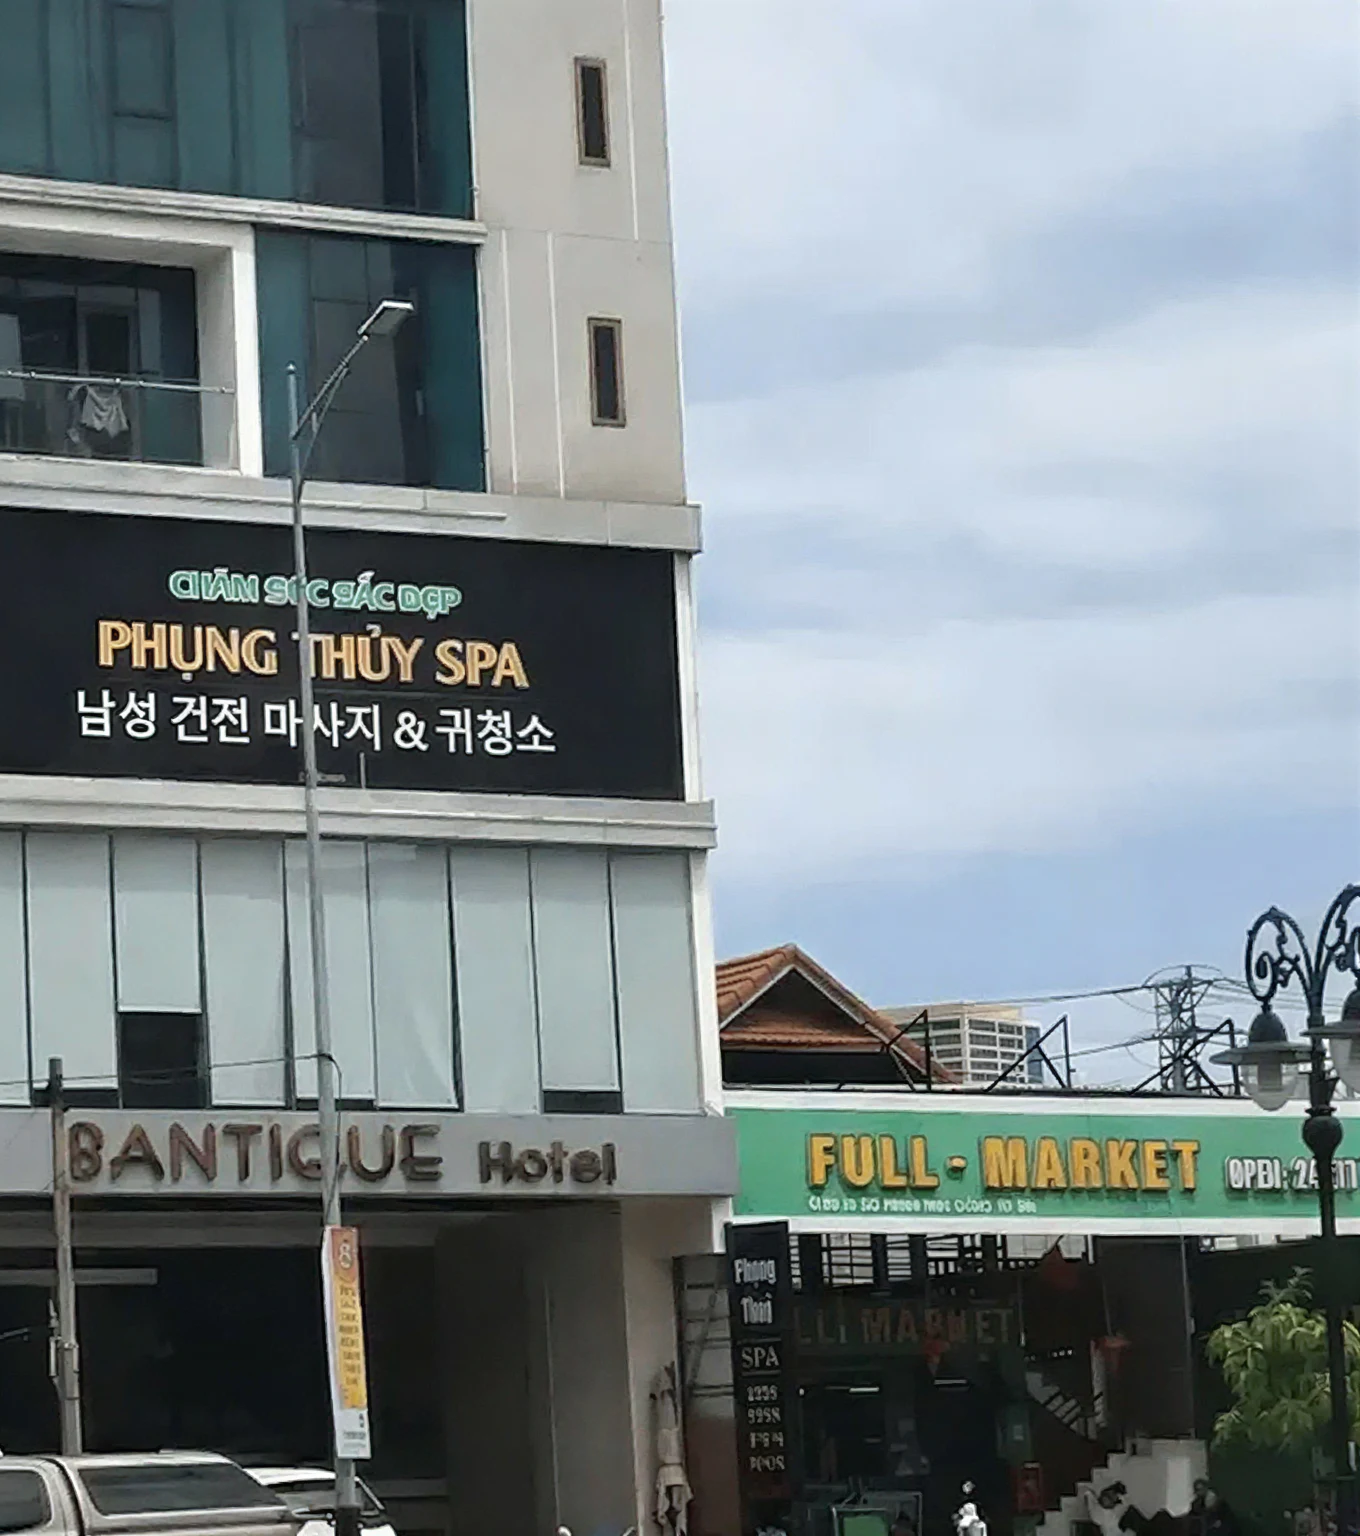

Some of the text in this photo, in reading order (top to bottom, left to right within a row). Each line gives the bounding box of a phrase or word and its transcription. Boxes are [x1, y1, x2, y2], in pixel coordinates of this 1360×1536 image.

[332, 570, 396, 611] SẮC
[97, 619, 278, 681] PHỤNG
[434, 639, 529, 689] SPA
[76, 689, 556, 757] 남성 건전 마사지 & 귀청소
[70, 1121, 618, 1184] BANTIQUE Hotel
[807, 1133, 939, 1187] FULL
[982, 1137, 1201, 1190] MARKET
[741, 1345, 780, 1369] SPA
